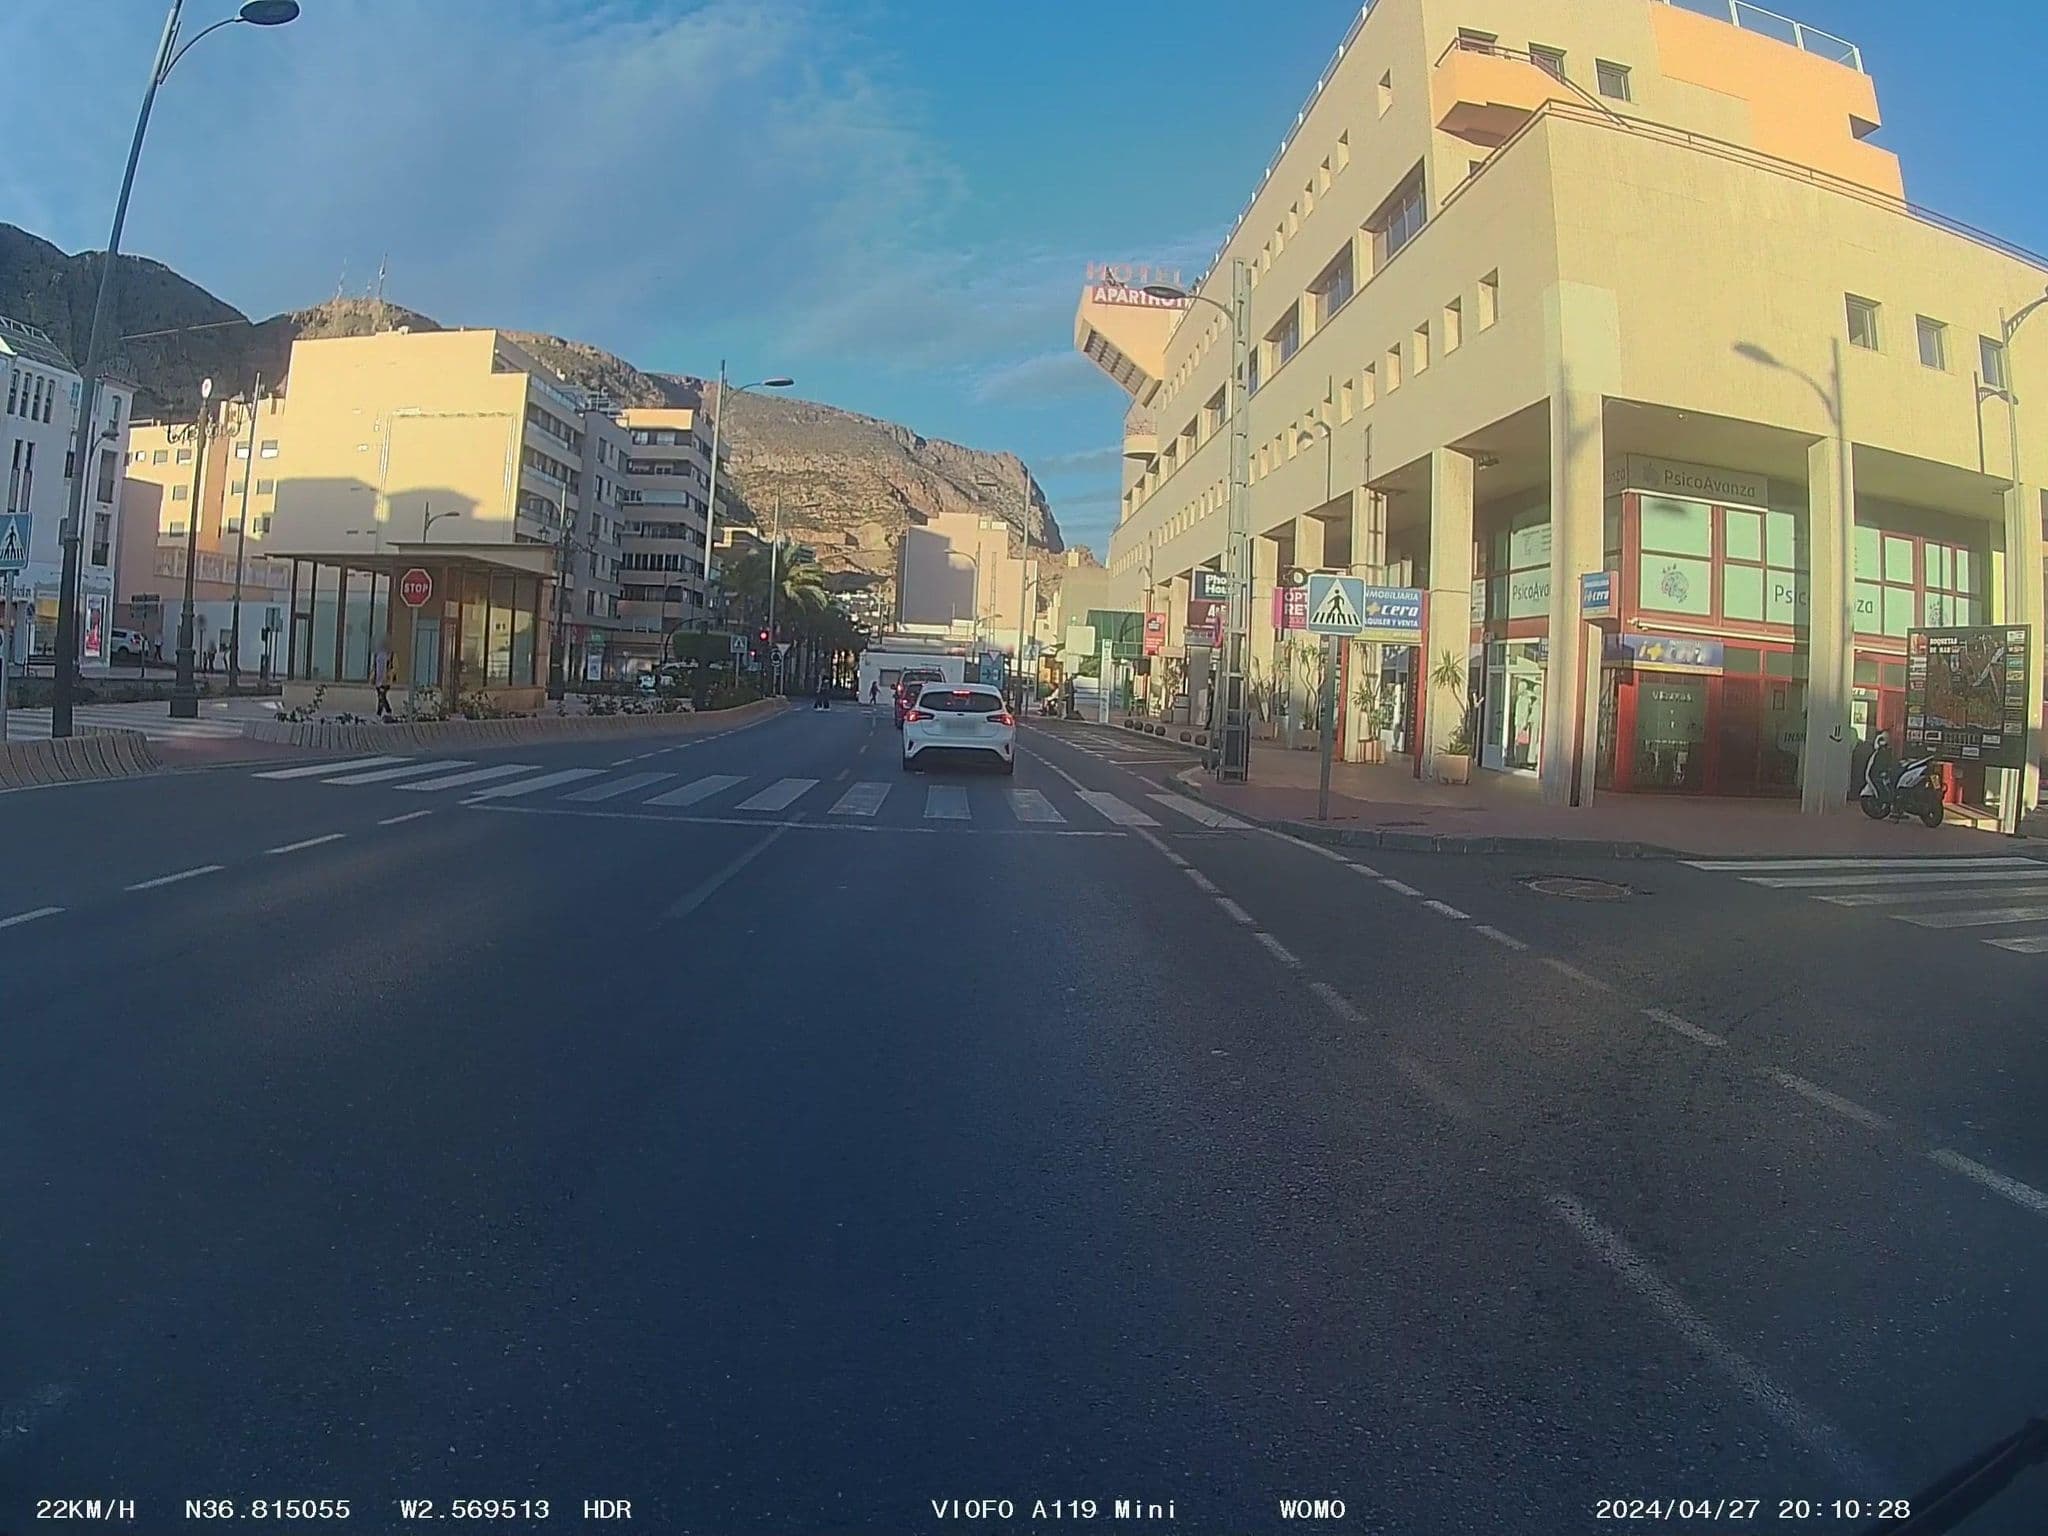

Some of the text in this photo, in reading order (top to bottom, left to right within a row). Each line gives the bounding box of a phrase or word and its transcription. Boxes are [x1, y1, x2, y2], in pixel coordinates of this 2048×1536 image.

[1086, 262, 1183, 286] HOTEL
[1664, 469, 1755, 498] PsicoAvanza
[404, 583, 429, 593] STOP
[1365, 590, 1419, 601] NMOBILIARIA
[1512, 582, 1551, 601] PsicoAva
